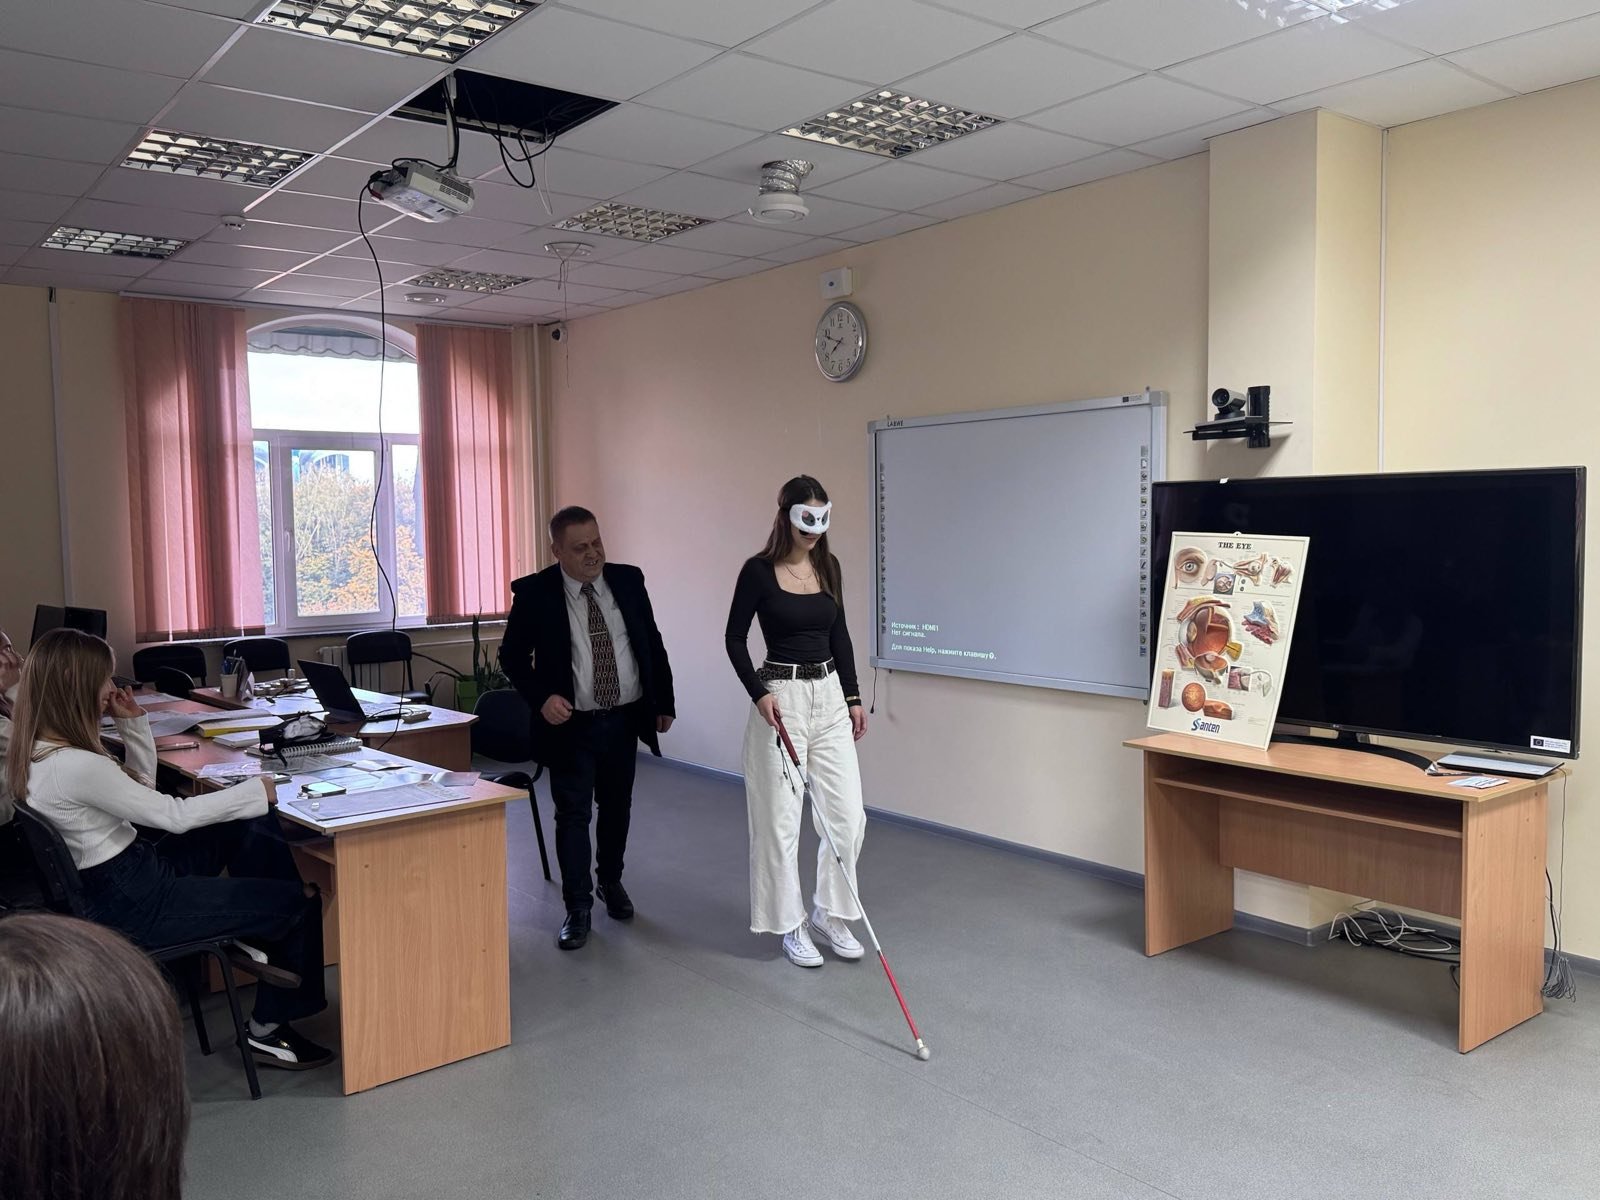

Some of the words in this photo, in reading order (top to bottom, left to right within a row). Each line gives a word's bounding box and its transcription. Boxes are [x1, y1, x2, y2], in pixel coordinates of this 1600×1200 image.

[1218, 541, 1234, 549] THE
[1236, 542, 1252, 550] EYE
[902, 630, 926, 638] сигнала.
[891, 643, 902, 652] Для
[903, 644, 922, 653] показа
[923, 645, 937, 655] Help,
[938, 648, 963, 657] нажмите
